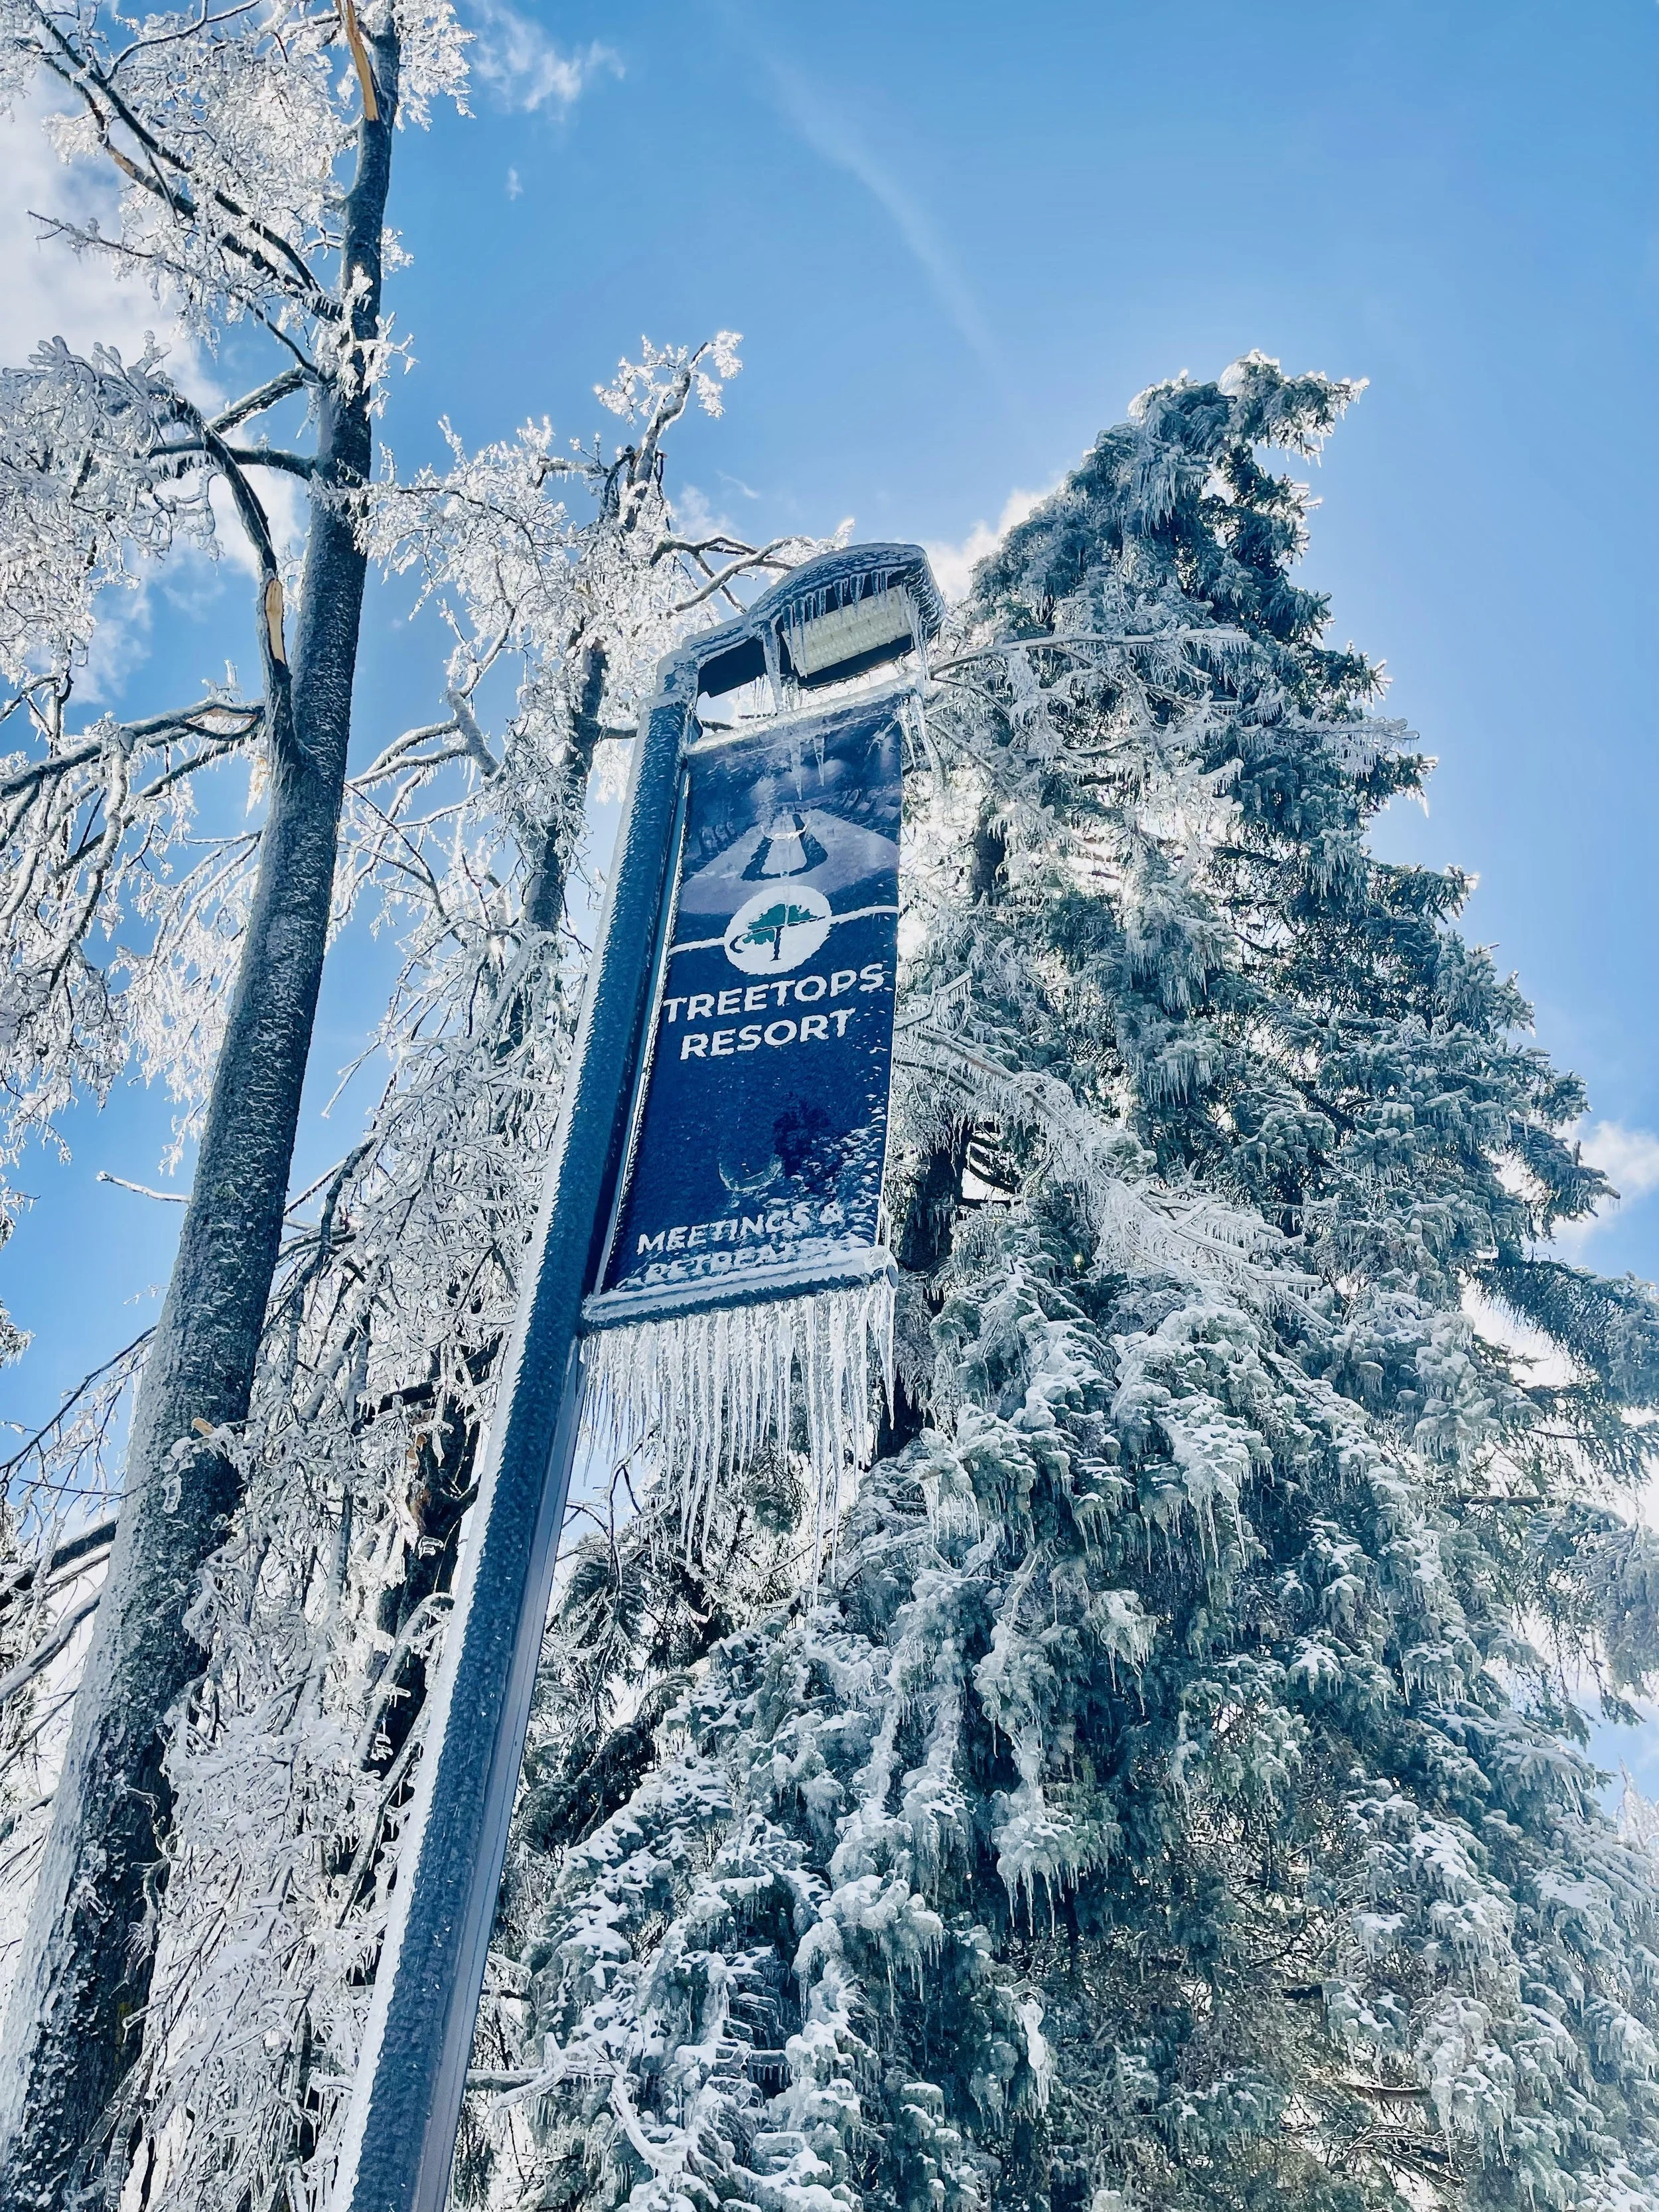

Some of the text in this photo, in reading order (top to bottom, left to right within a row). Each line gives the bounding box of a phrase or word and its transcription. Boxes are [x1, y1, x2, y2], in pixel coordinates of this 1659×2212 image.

[663, 963, 885, 1023] TREETOPS
[680, 1007, 855, 1060] RESORT
[636, 1201, 846, 1256] MEETINGS &
